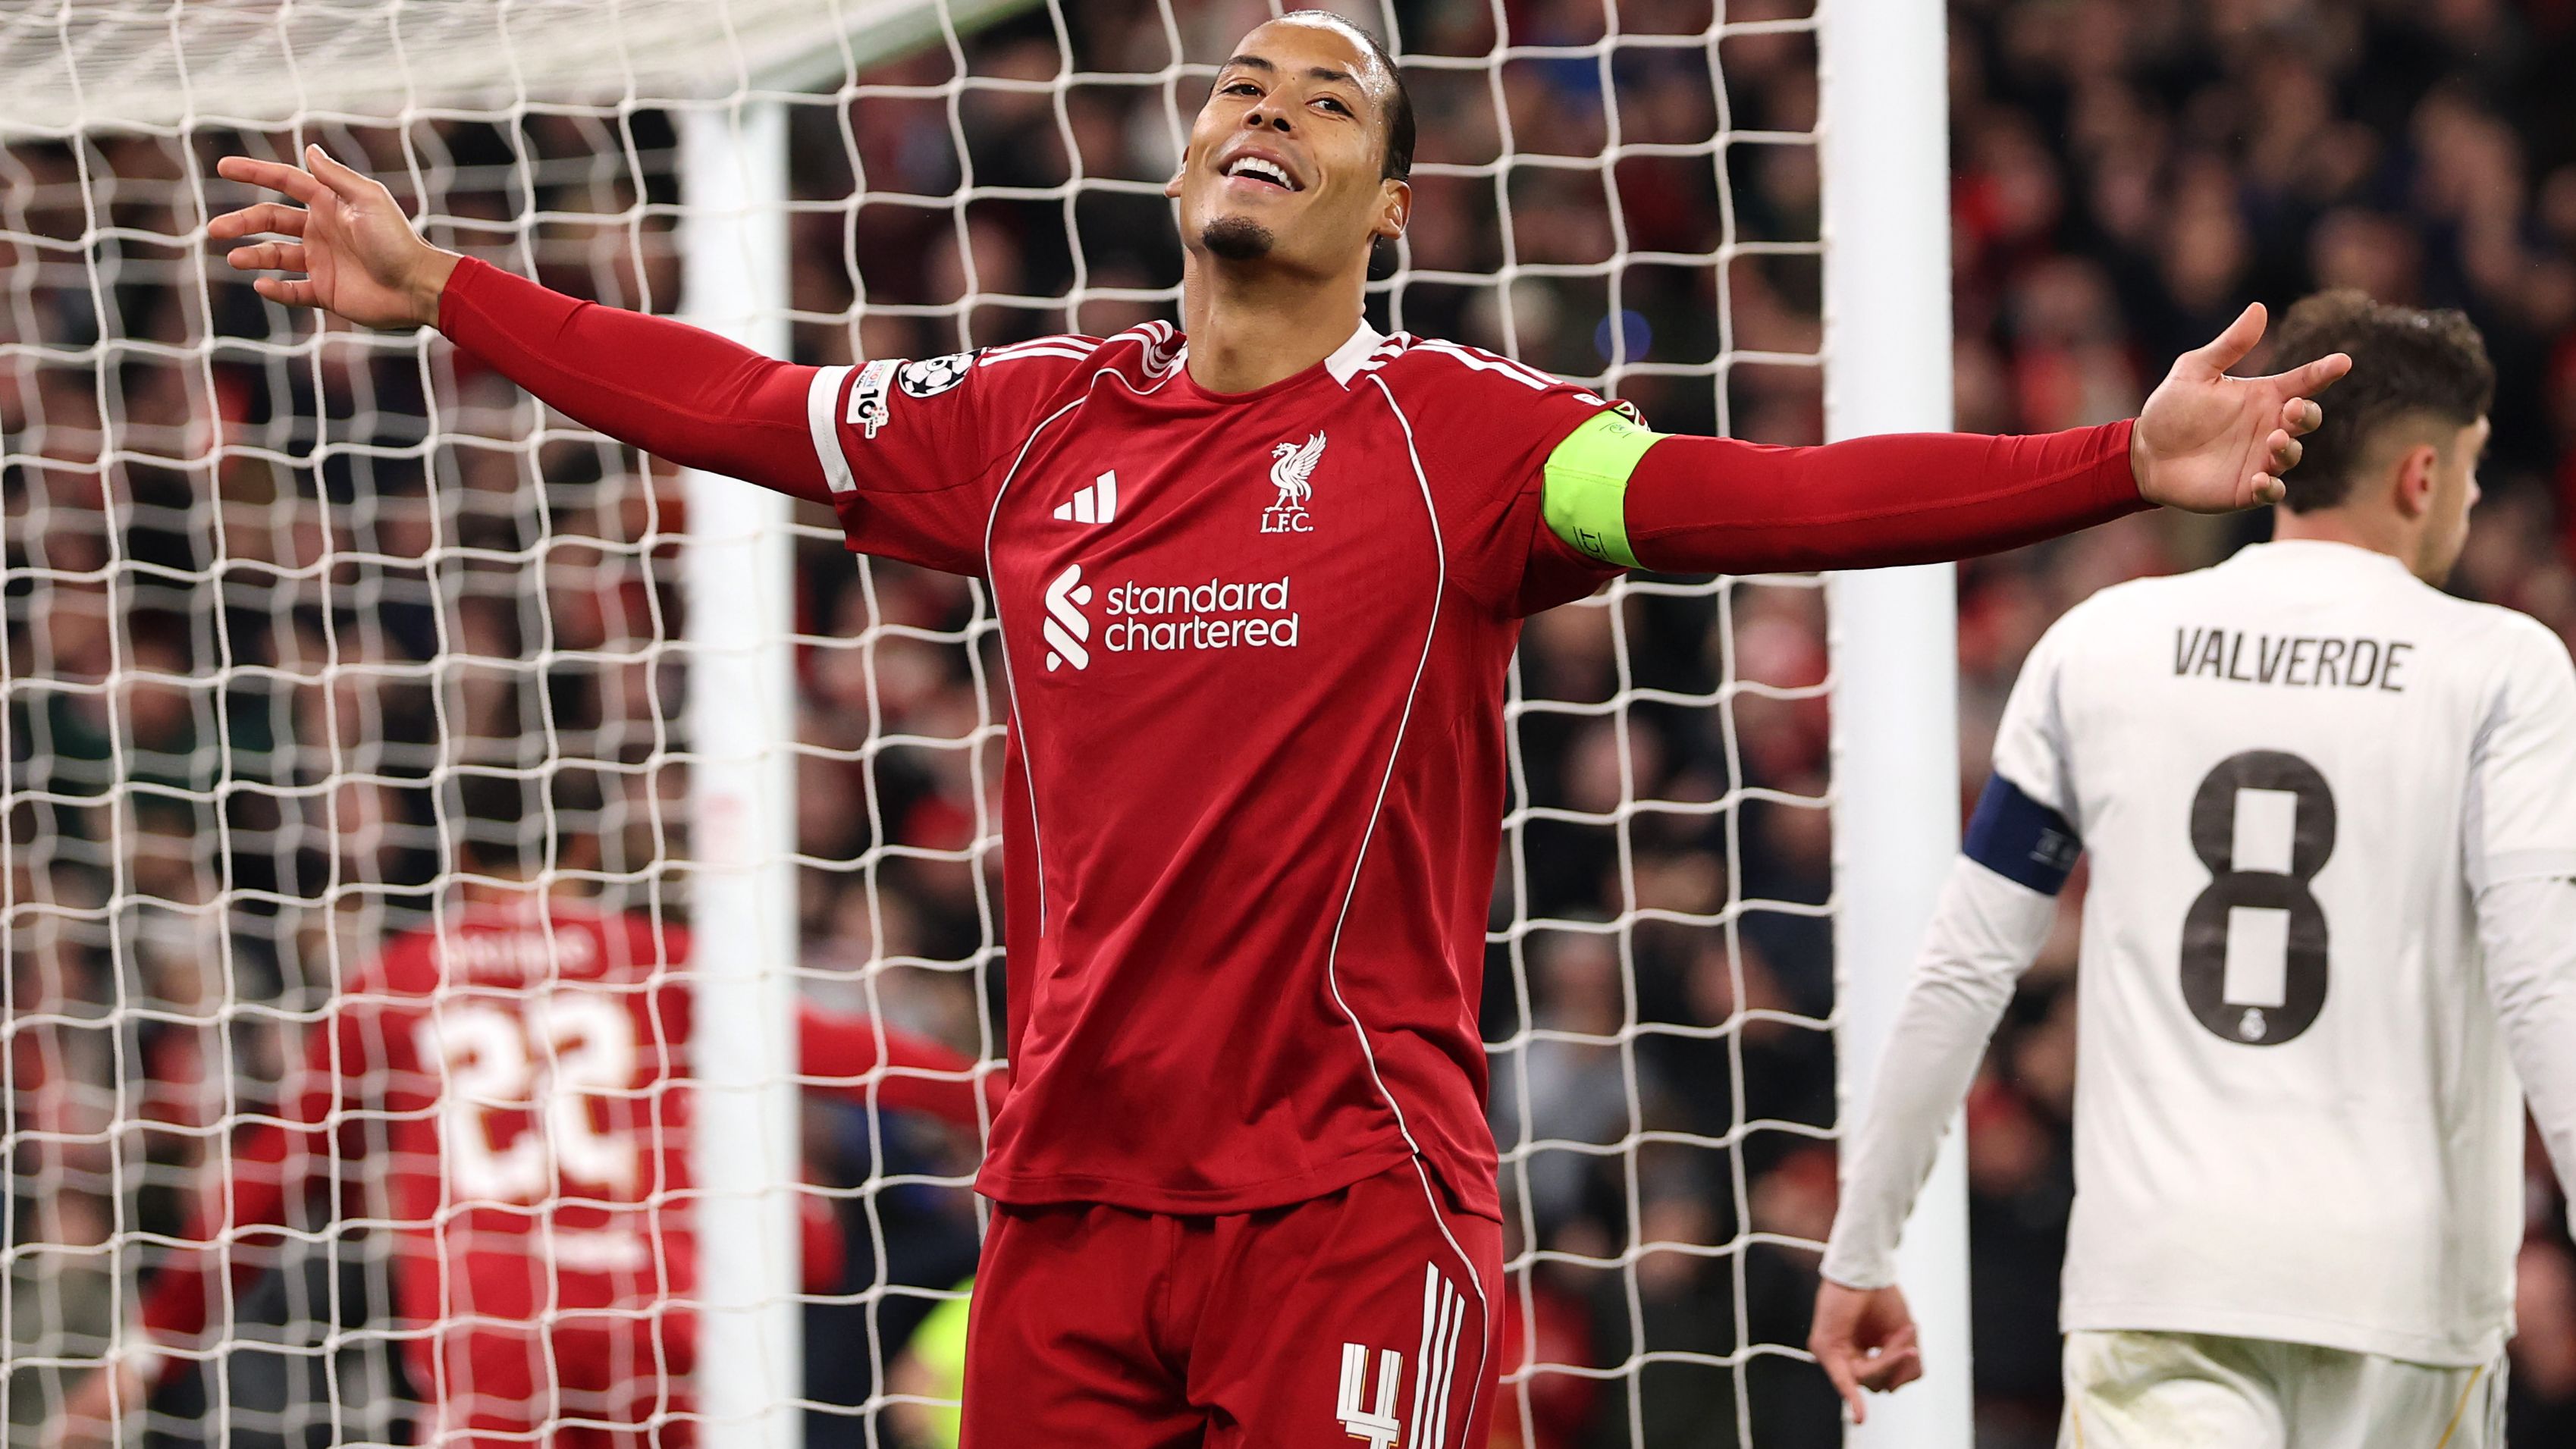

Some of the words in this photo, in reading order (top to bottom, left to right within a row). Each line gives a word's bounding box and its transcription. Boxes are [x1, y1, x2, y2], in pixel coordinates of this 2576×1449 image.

[858, 388, 879, 419] 10
[1260, 513, 1314, 533] L.F.C.
[1106, 576, 1289, 616] standard
[1105, 612, 1299, 652] chartered
[2174, 627, 2414, 692] VALVERDE
[2181, 749, 2336, 1046] 8
[413, 992, 639, 1200] 22
[1335, 1342, 1403, 1449] 4
